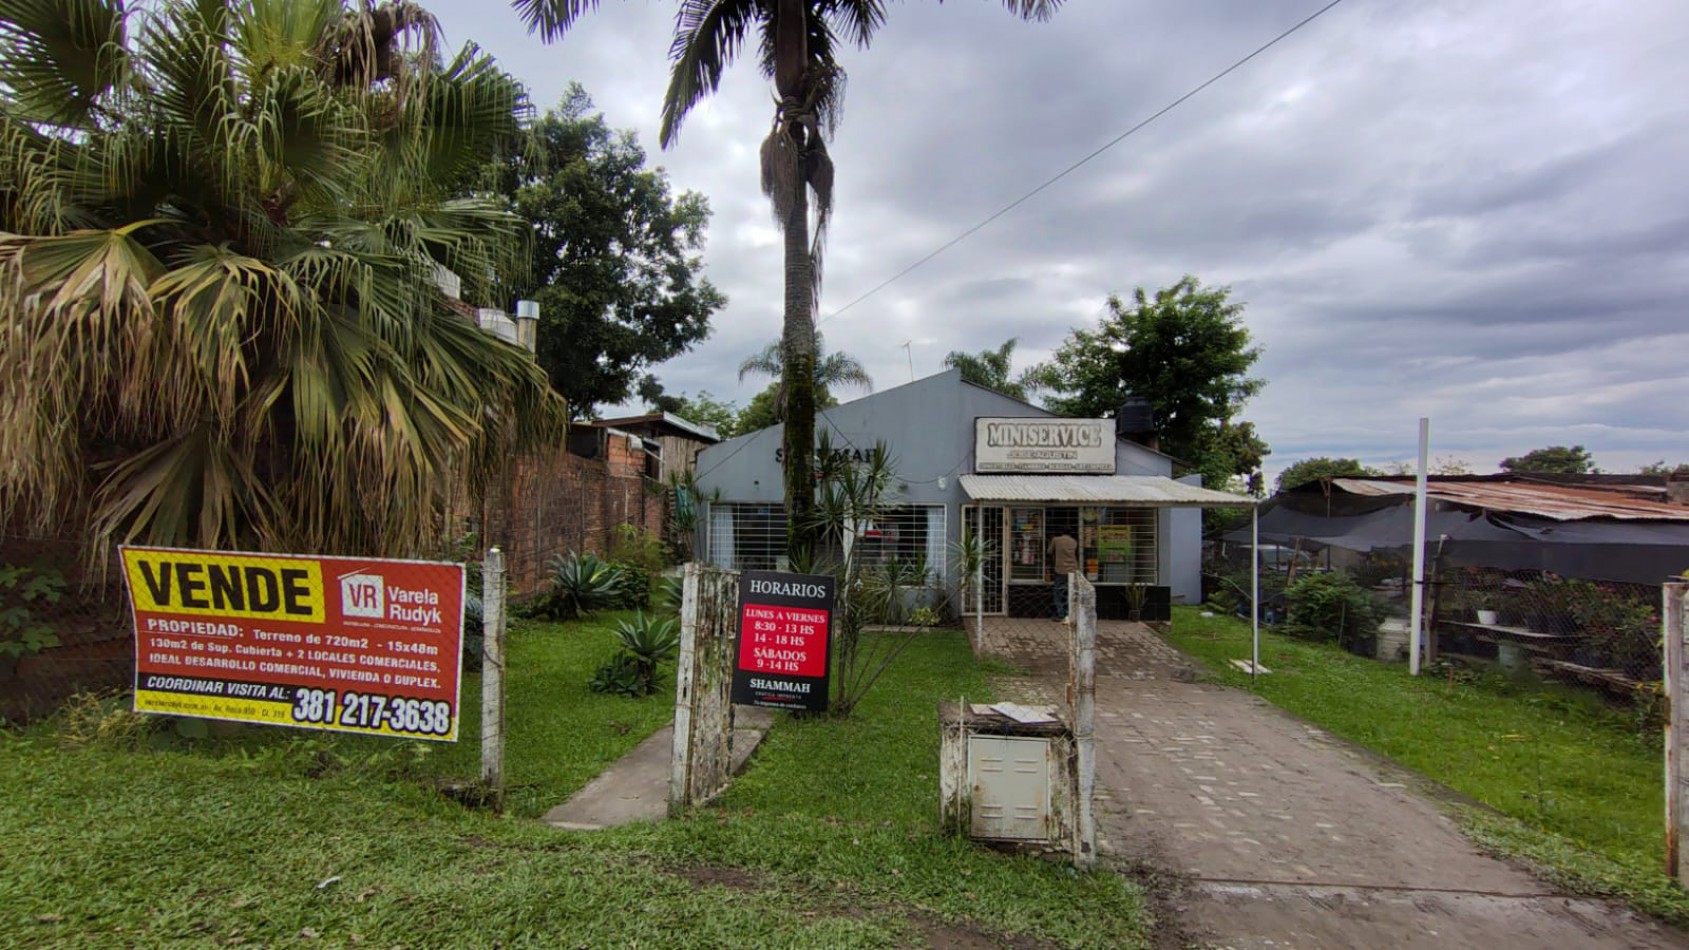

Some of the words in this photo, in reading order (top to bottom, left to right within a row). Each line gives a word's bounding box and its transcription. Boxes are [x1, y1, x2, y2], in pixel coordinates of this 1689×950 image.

[987, 422, 1102, 448] MINISERVICE
[137, 559, 313, 615] VENDE
[348, 583, 377, 609] VR
[387, 585, 439, 605] Varela
[750, 580, 826, 598] HORARIOS
[389, 604, 442, 626] Rudyk
[746, 608, 774, 619] LUNES
[776, 611, 784, 620] A
[786, 612, 825, 623] VIERNES
[147, 618, 244, 637] PROPIEDAD:
[253, 629, 302, 643] Terreno
[306, 633, 321, 645] de
[325, 635, 369, 649] 720m2
[387, 641, 439, 656] 15x48m
[754, 620, 776, 631] 8:30
[785, 623, 797, 633] 13
[800, 624, 815, 635] HS
[754, 632, 766, 642] 14
[775, 635, 788, 645] 18
[790, 636, 805, 646] HS
[150, 638, 187, 650] 130m2
[191, 641, 204, 651] de
[207, 644, 232, 654] Sup.
[235, 644, 283, 658] Cubierta
[286, 650, 294, 658] +
[297, 649, 305, 660] 2
[308, 650, 356, 664] LOCALES
[359, 655, 441, 673] COMERCIALES,
[754, 645, 807, 662] SÁBADOS
[757, 658, 764, 668] 9
[784, 661, 799, 671] HS
[150, 653, 181, 665] IDEAL
[185, 656, 256, 671] DESARROLLO
[260, 662, 326, 679] COMERCIAL,
[329, 668, 379, 683] VIVIENDA
[383, 674, 392, 684] O
[395, 675, 442, 689] DUPLEX.
[147, 676, 223, 694] COORDINAR
[227, 682, 267, 698] VISITA
[269, 687, 290, 700] AL:
[749, 678, 811, 693] SHAMMAH
[293, 687, 336, 723] 381
[340, 691, 451, 735] 217-3638
